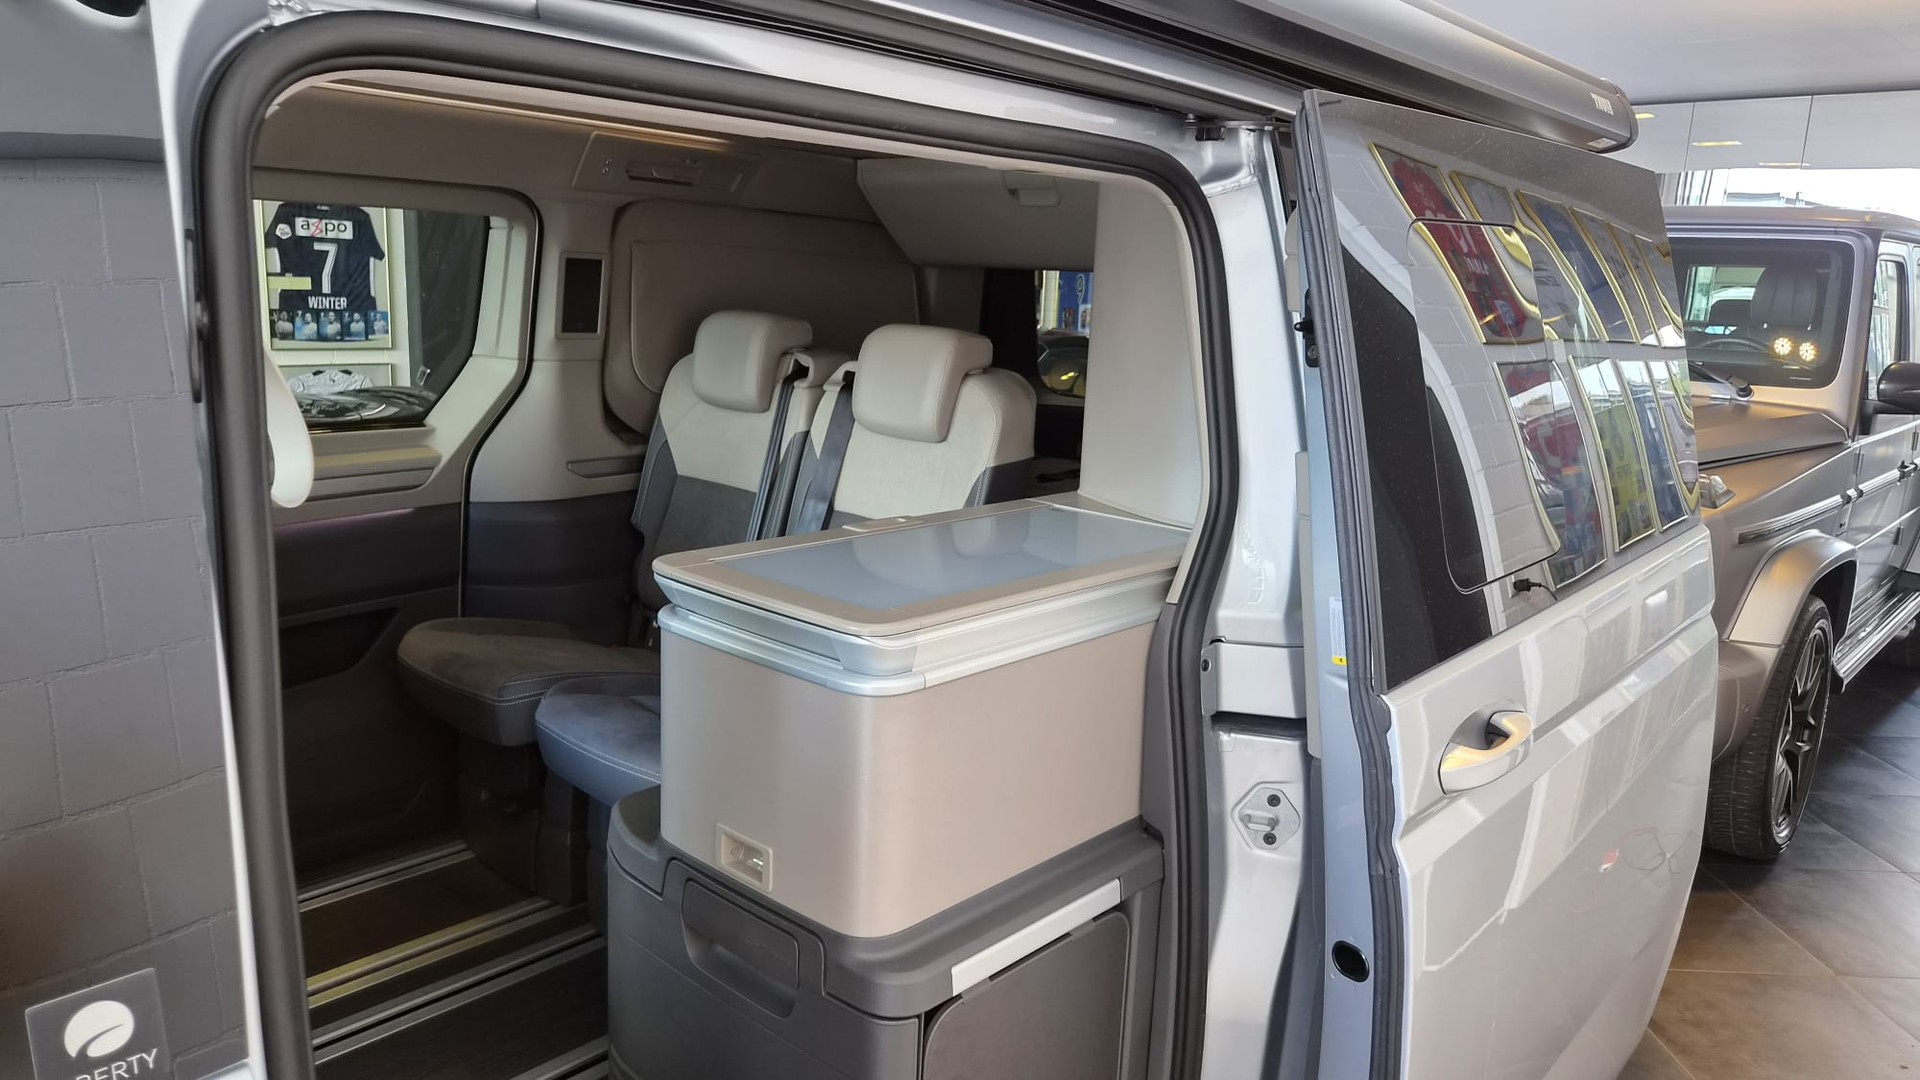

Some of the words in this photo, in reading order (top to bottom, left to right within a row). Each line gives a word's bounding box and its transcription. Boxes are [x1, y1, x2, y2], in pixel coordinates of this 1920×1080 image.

[313, 242, 338, 294] 7
[308, 295, 348, 310] WINTER
[76, 1048, 158, 1080] ERTY
